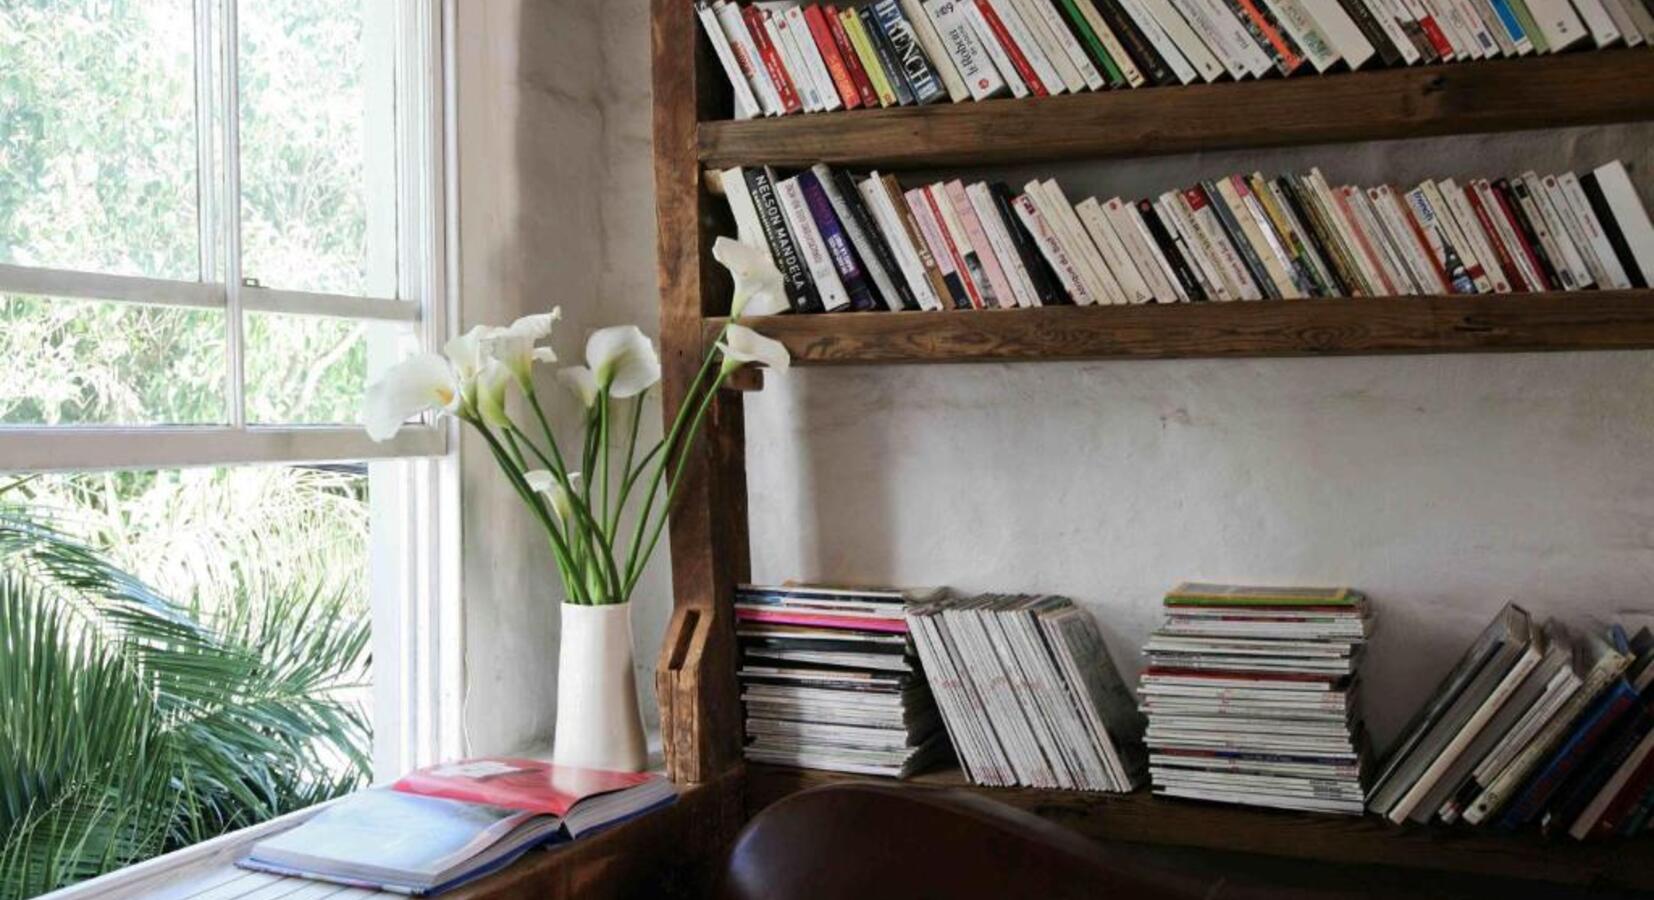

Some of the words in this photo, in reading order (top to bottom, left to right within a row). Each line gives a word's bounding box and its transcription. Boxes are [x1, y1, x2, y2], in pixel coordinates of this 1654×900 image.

[878, 3, 932, 88] FRENCH
[756, 175, 781, 225] NELSON
[776, 227, 805, 290] MANDELA
